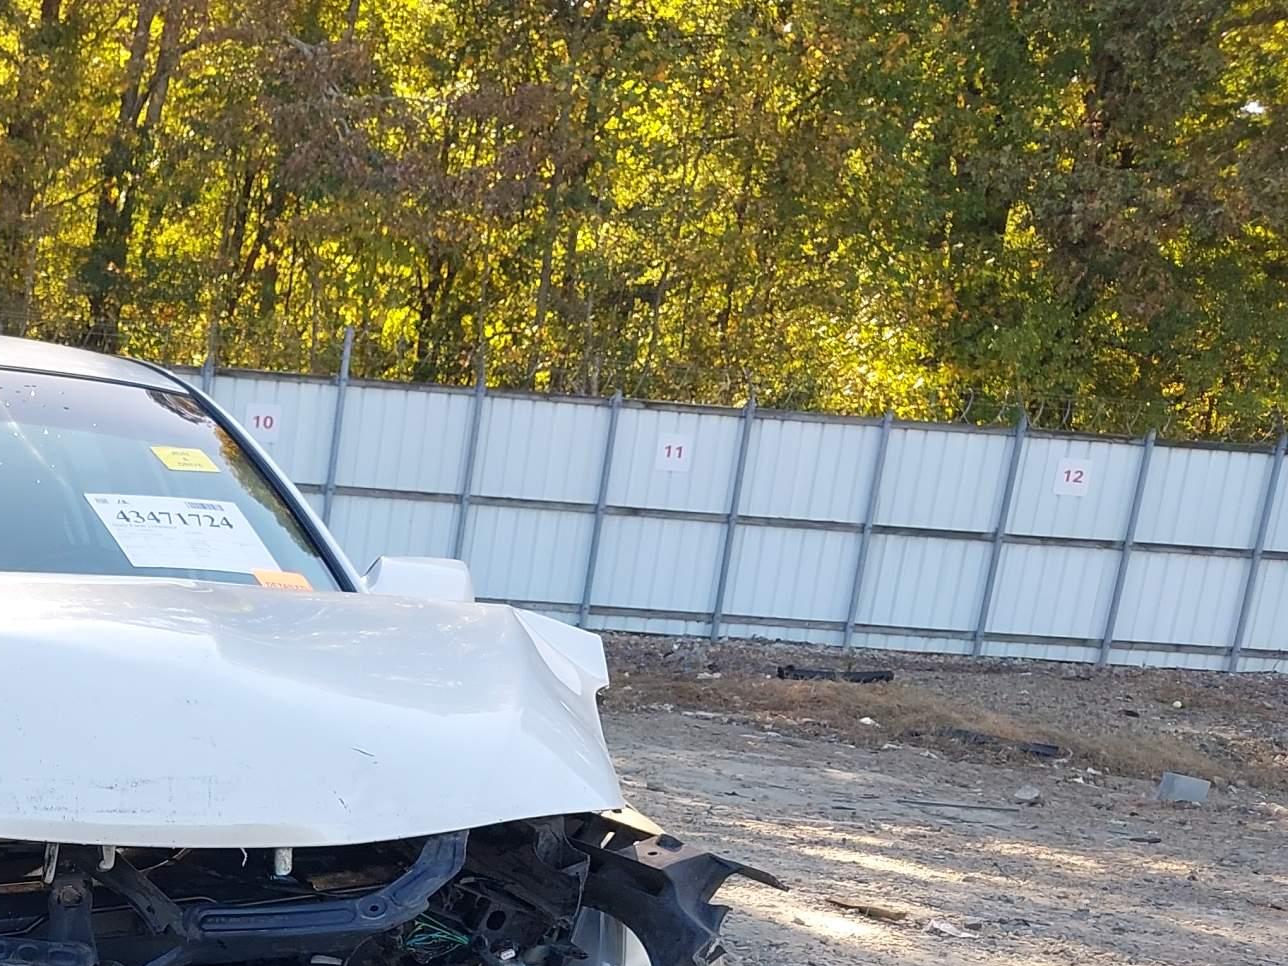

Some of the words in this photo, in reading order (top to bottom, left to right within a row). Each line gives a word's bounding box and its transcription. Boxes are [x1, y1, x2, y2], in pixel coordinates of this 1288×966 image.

[253, 415, 274, 429] 10
[664, 445, 683, 459] 11
[1063, 470, 1084, 484] 12
[116, 509, 234, 529] 43471724
